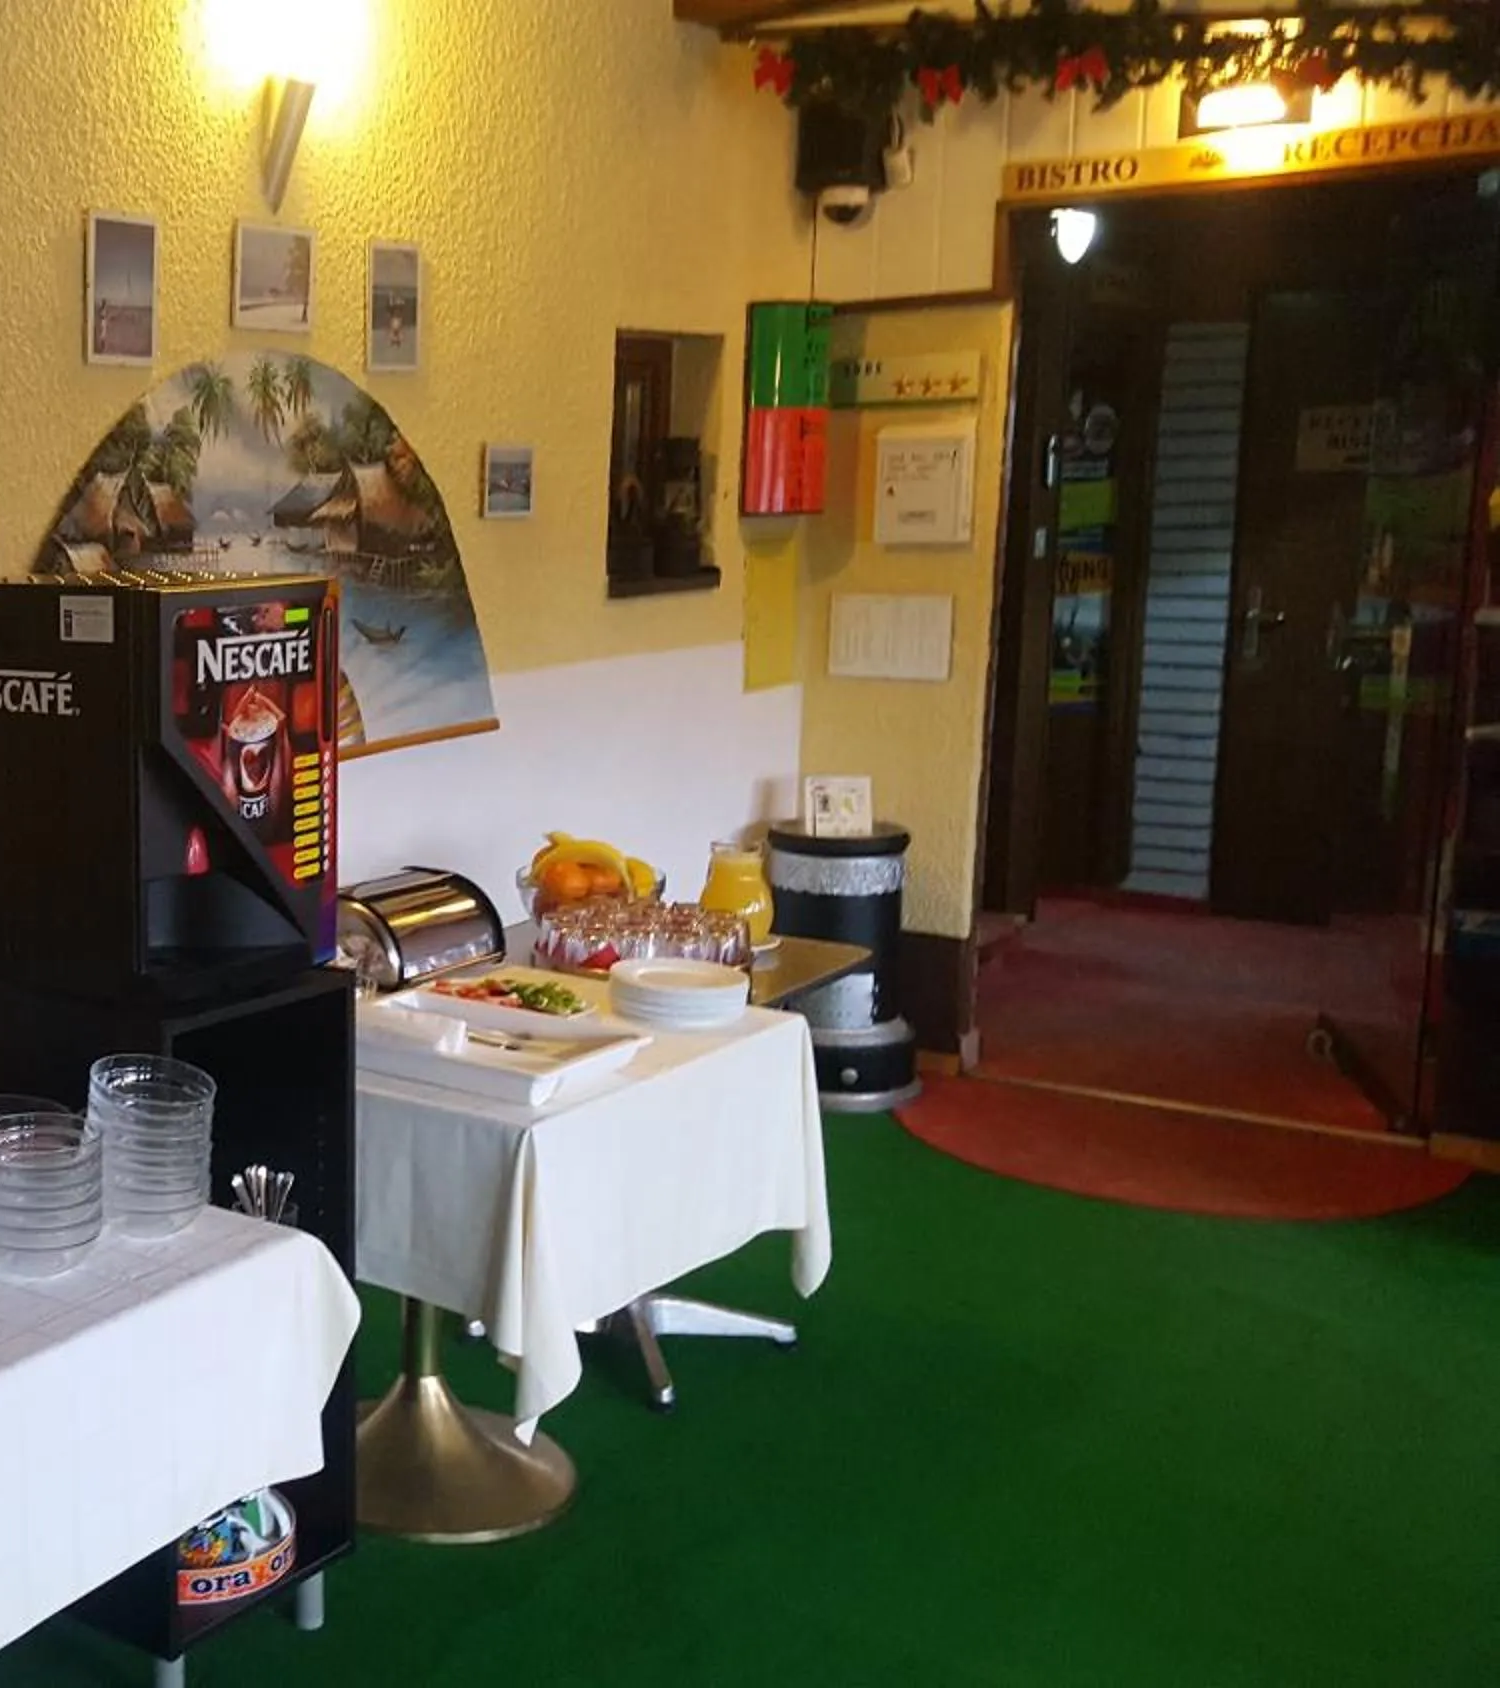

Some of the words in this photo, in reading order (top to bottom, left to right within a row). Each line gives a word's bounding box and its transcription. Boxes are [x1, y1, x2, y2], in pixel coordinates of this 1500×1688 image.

[1016, 155, 1139, 192] BISTRO
[1283, 117, 1500, 164] RECEPCIJA
[197, 628, 311, 684] NESCAFÉ
